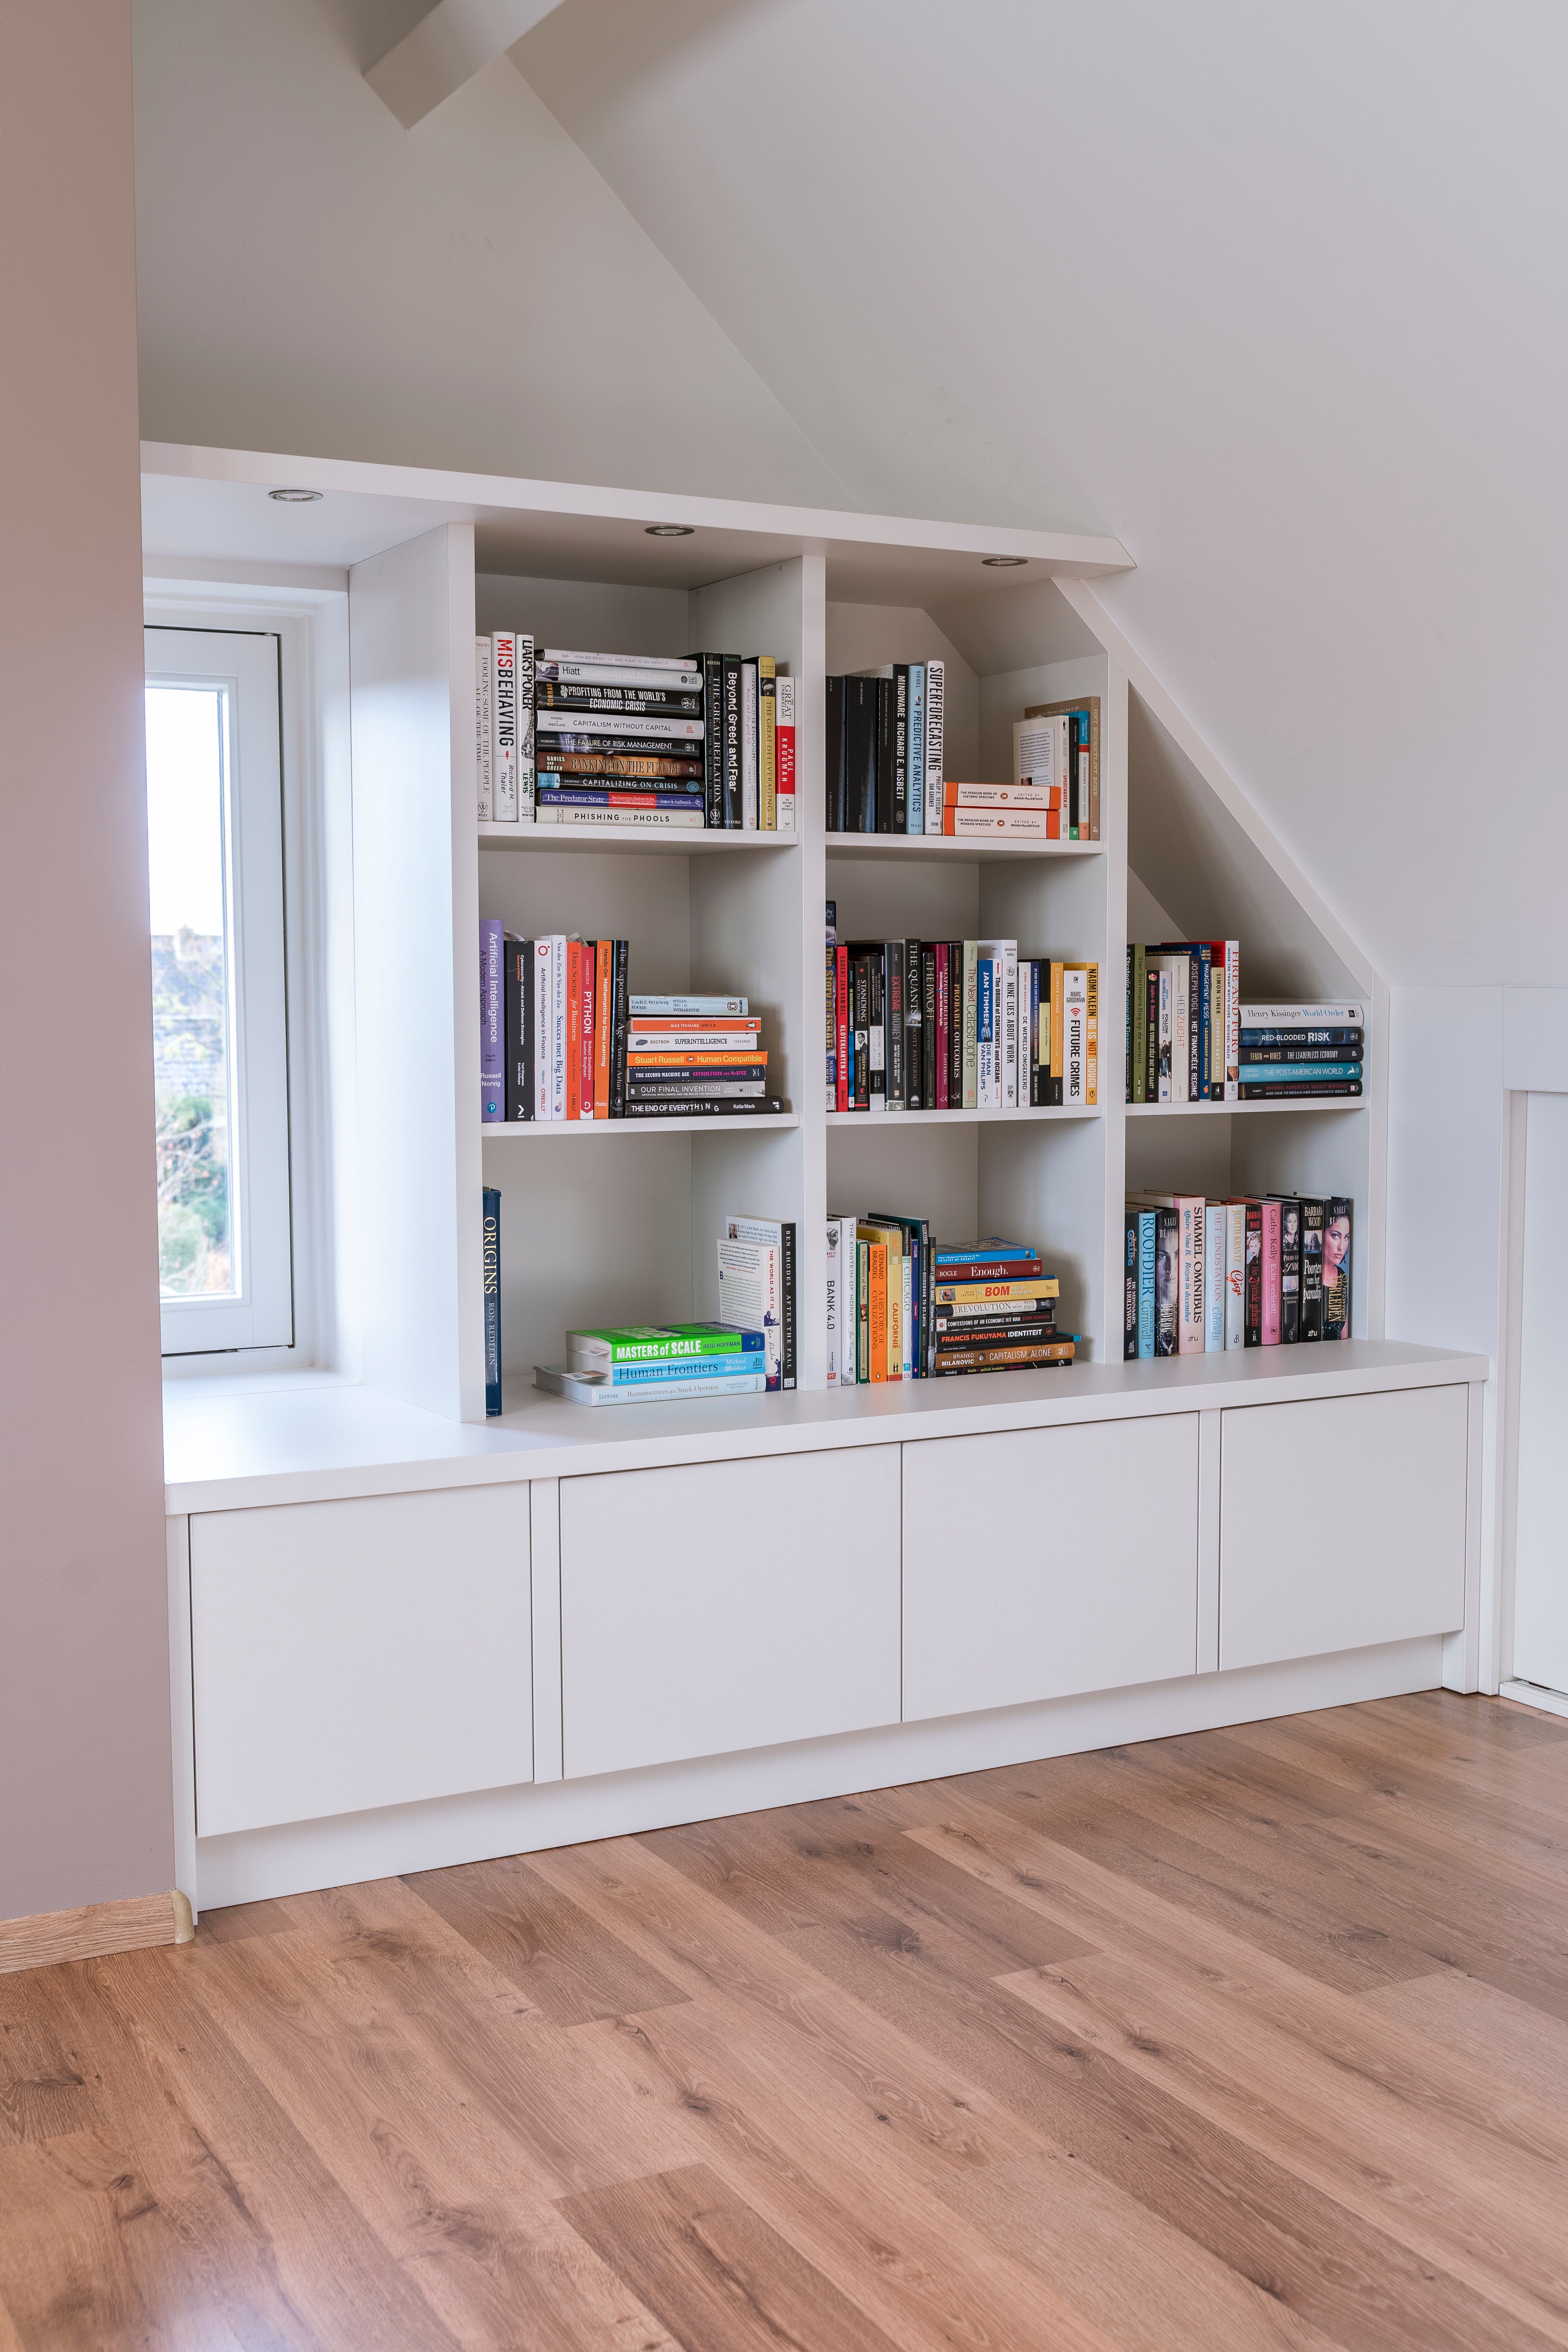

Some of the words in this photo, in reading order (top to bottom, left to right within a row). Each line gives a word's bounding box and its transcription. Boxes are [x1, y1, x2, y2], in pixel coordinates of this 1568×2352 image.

[522, 640, 532, 671] LIAR'S
[563, 666, 580, 675] Hiatt
[497, 639, 514, 746] MISBEHAVING
[522, 674, 532, 710] POKER
[568, 686, 601, 697] PROFITING
[604, 688, 621, 698] FROM
[624, 690, 636, 699] THE
[639, 691, 666, 702] WORLD'S
[728, 672, 737, 710] Beyond
[590, 699, 622, 709] ECONOMIC
[625, 701, 646, 711] CRISIS
[728, 715, 737, 744] Greed
[928, 667, 943, 771] SUPERFORECASTING
[913, 710, 922, 762] PREDICTIVE
[728, 747, 738, 767] and
[728, 769, 738, 792] Fear
[913, 764, 922, 813] ANALYTICS
[489, 932, 498, 977] Artificial
[892, 976, 900, 1011] EXTREME
[909, 969, 918, 1016] QUANTS
[1088, 969, 1097, 992] NAOMI
[488, 980, 499, 1043] Intelligence
[1088, 995, 1096, 1016] KLEIN
[1248, 1010, 1269, 1019] Henry
[1271, 1009, 1301, 1020] Kissinger
[892, 1013, 901, 1040] MONEY
[966, 1004, 977, 1067] Catastrophe
[1088, 1020, 1096, 1030] NO
[1307, 1032, 1330, 1042] RISK
[1070, 1020, 1080, 1058] FUTURE
[1088, 1042, 1096, 1056] NOT
[723, 1055, 762, 1063] Compatible
[1070, 1061, 1080, 1097] CRIMES
[1088, 1058, 1096, 1088] ENOUGH
[1194, 1207, 1203, 1258] SIMMEL
[1232, 1210, 1241, 1235] JUDITH
[484, 1216, 497, 1294] ORIGINS
[1142, 1217, 1155, 1296] ROOFDIER
[1269, 1238, 1277, 1261] Kelly
[971, 1265, 1008, 1278] Enough.
[770, 1287, 774, 1295] AS
[985, 1285, 1010, 1297] BOM
[1194, 1261, 1203, 1324] OMNIBUS
[971, 1332, 1007, 1341] FUKUYAMA
[1008, 1329, 1042, 1337] IDENTITEIT
[617, 1343, 658, 1359] MASTERS
[660, 1343, 669, 1356] of
[672, 1341, 702, 1355] SCALE
[989, 1351, 1028, 1361] CAPITALISM,
[1031, 1349, 1051, 1357] ALONE
[619, 1368, 664, 1380] Human
[667, 1363, 718, 1376] Frontiers
